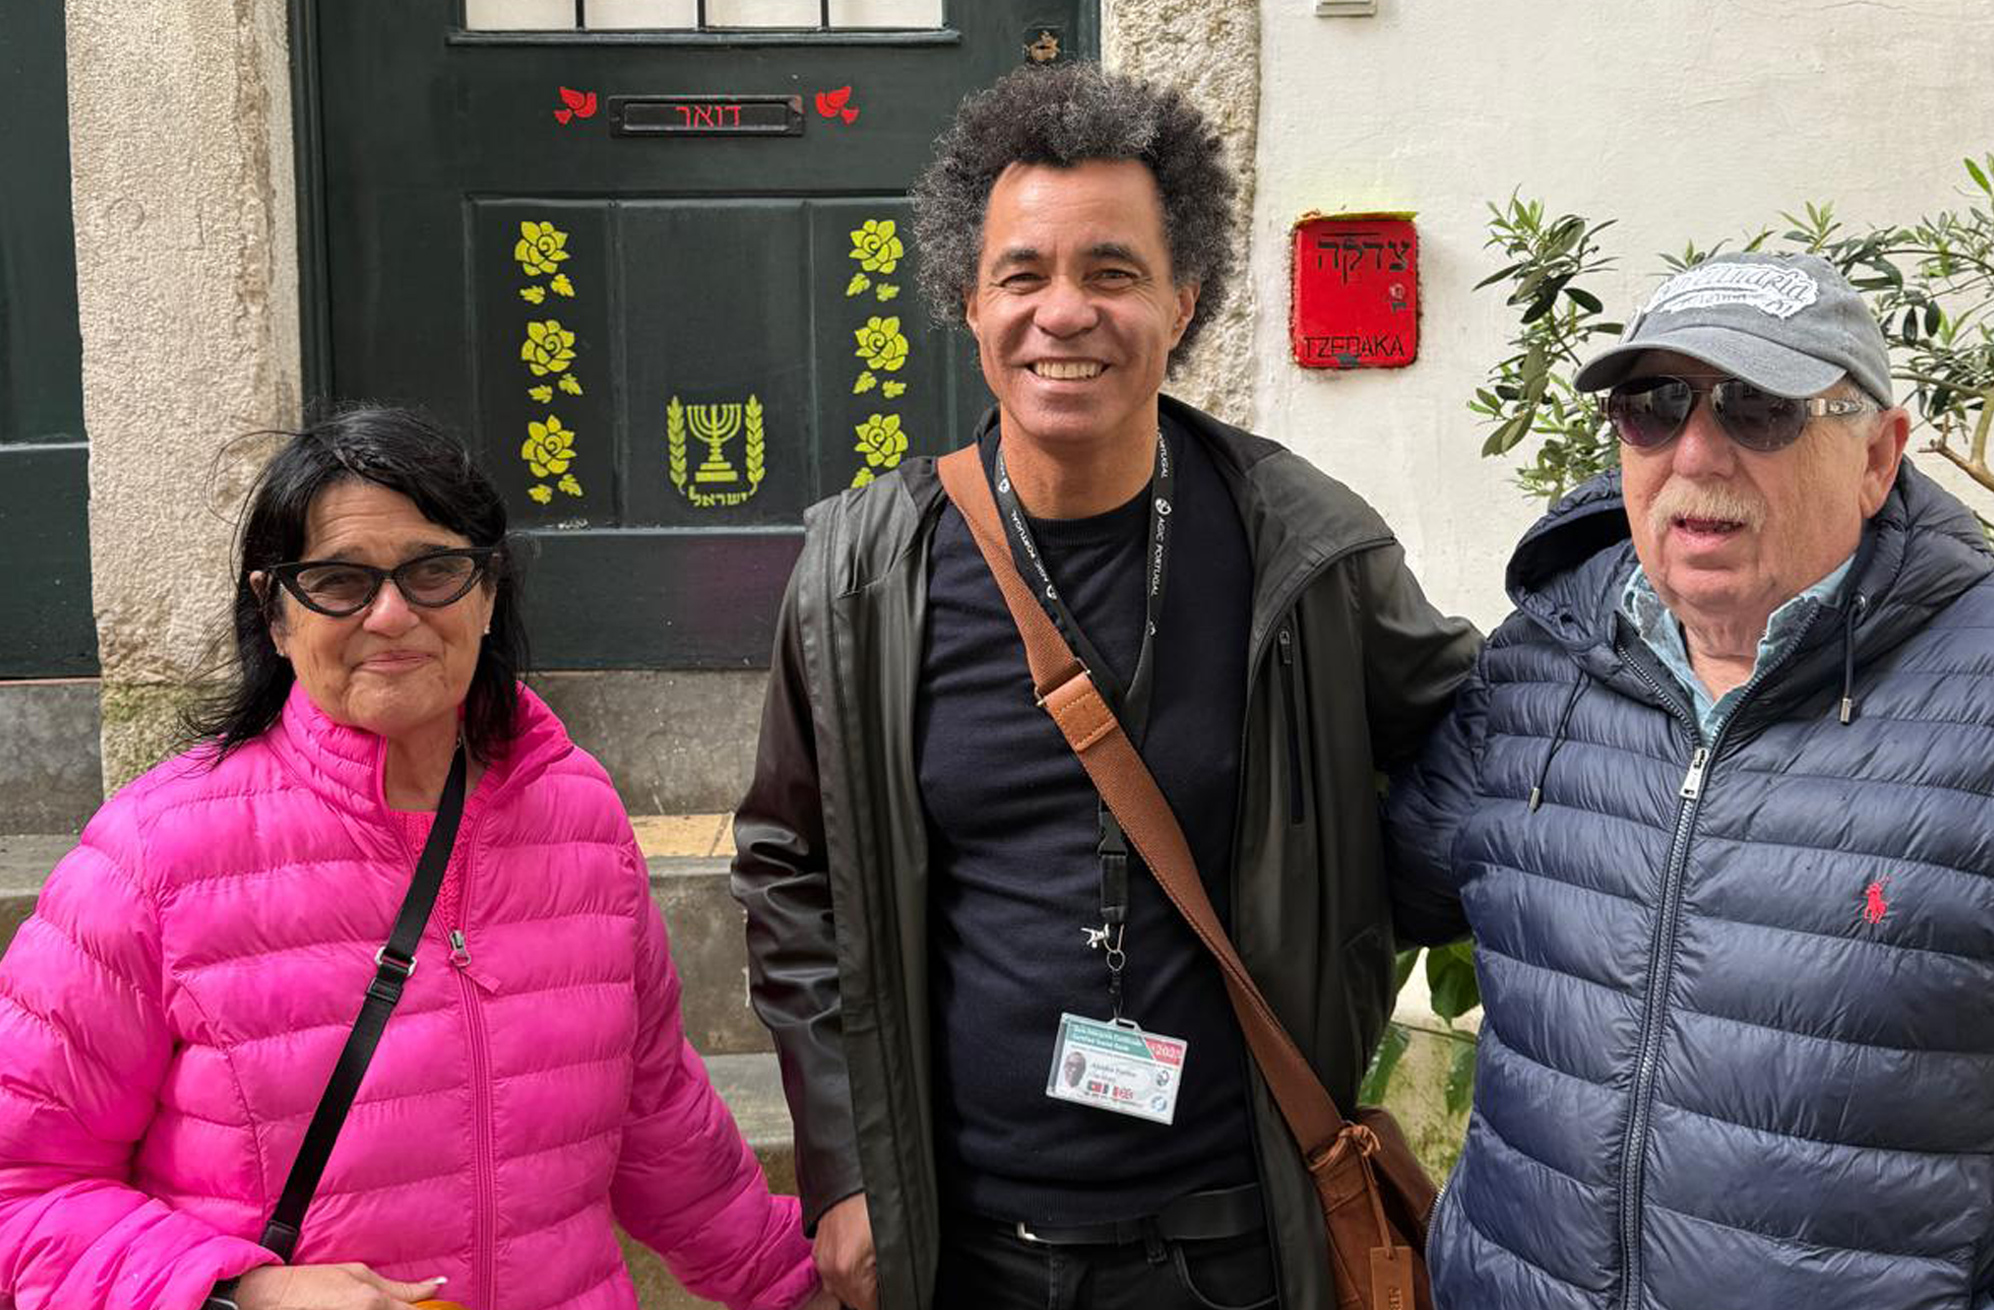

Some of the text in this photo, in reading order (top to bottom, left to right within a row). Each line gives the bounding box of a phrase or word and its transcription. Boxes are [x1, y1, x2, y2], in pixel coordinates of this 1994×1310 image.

[675, 104, 742, 128] דואר
[1318, 240, 1411, 286] צדקה
[1303, 336, 1406, 358] TZEDAKA
[688, 485, 748, 507] ישראל
[1010, 508, 1036, 559] PORTUGAL
[1151, 516, 1166, 597] AGIC PORTUGAL
